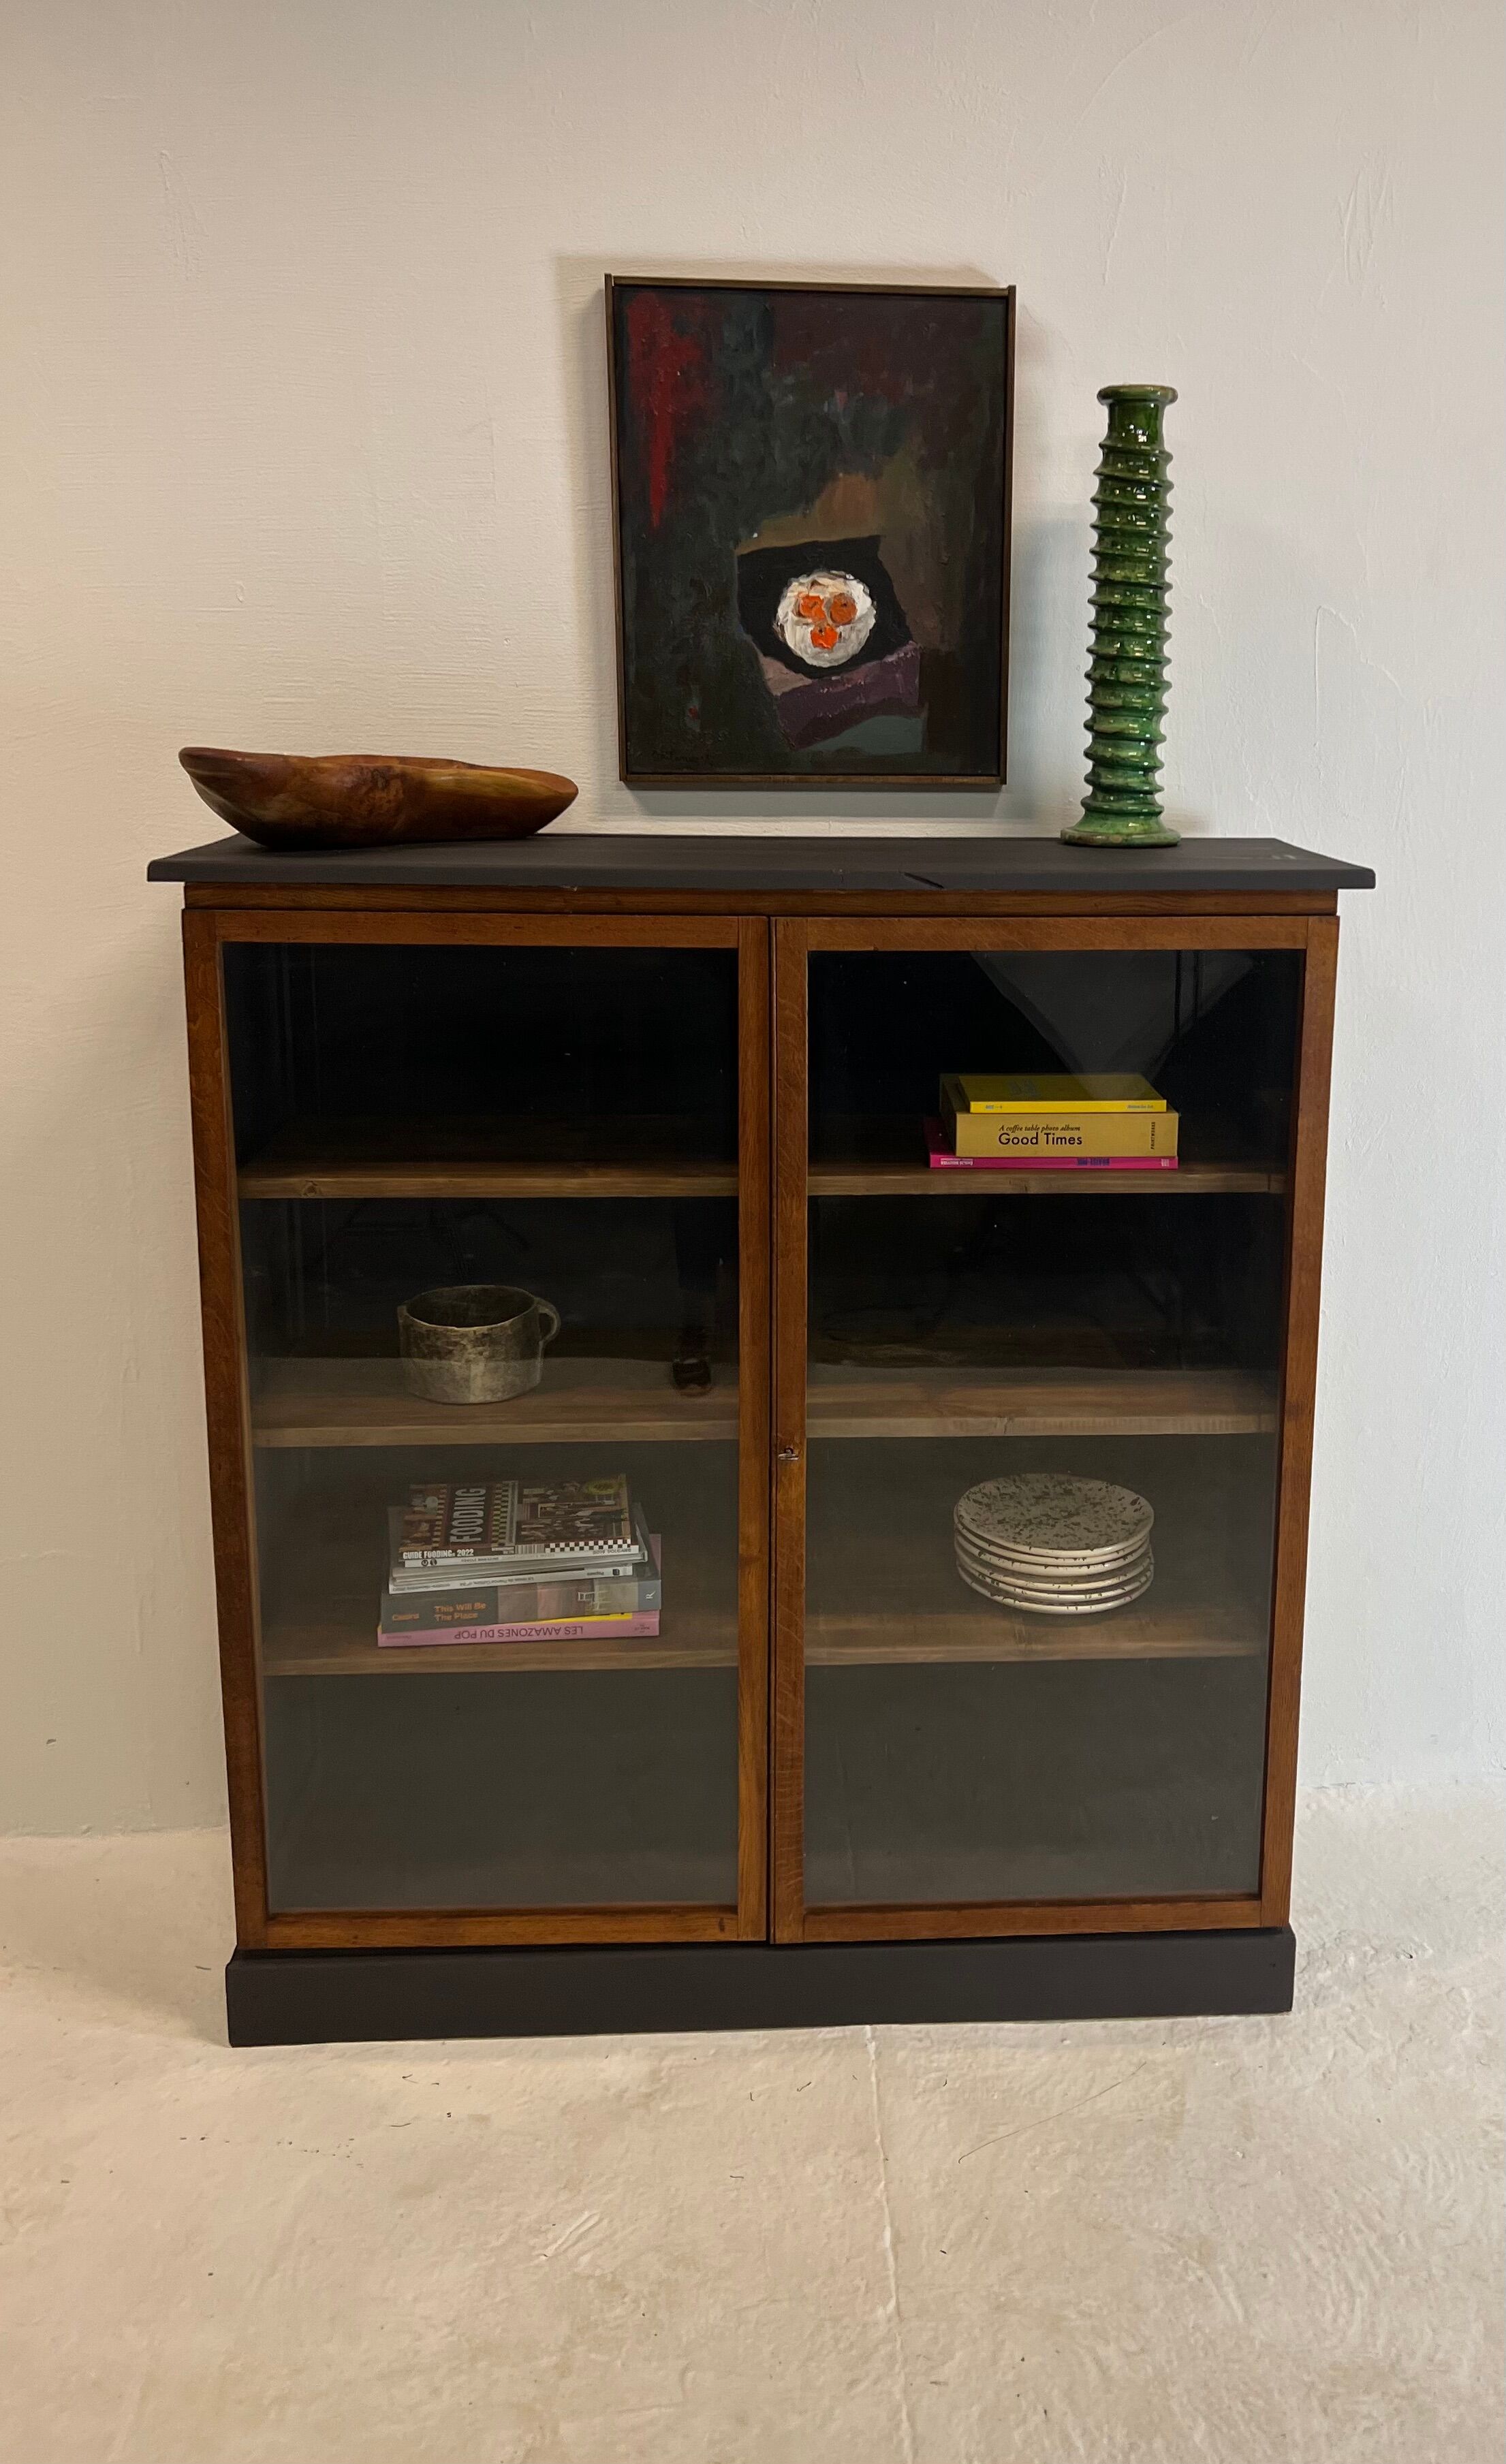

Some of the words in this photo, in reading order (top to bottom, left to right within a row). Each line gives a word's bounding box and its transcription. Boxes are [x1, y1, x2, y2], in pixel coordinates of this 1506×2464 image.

[1041, 1124, 1059, 1133] photo
[999, 1132, 1039, 1146] Good
[1044, 1132, 1082, 1146] Times
[449, 1488, 486, 1543] FOODING
[403, 1551, 422, 1560] GUIDE
[457, 1549, 474, 1557] 2022
[456, 1603, 473, 1611] Will
[473, 1602, 486, 1610] Be
[454, 1630, 477, 1639] POP
[480, 1630, 495, 1638] DU
[498, 1626, 561, 1637] AMAZONES
[565, 1626, 583, 1634] LES
